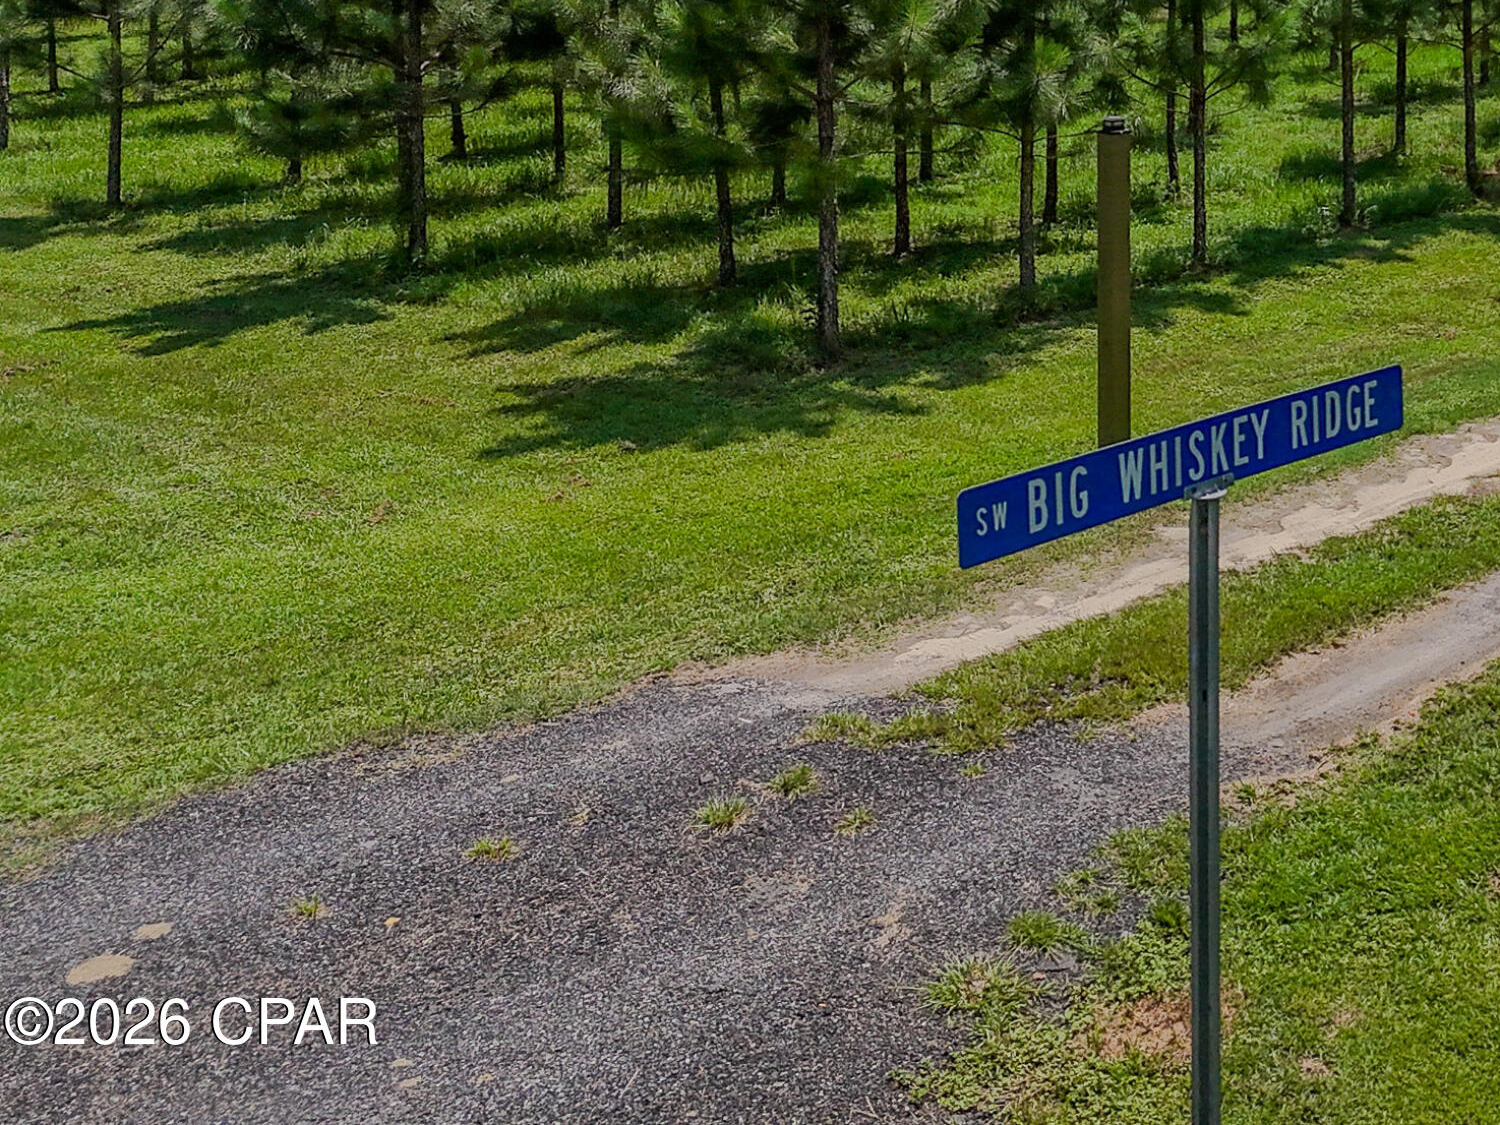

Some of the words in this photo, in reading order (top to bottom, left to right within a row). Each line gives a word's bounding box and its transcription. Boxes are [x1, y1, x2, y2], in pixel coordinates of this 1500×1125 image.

[976, 501, 1008, 536] SW
[1028, 465, 1089, 534] BIG
[1118, 409, 1269, 503] WHISKEY
[1290, 380, 1378, 449] RIDGE
